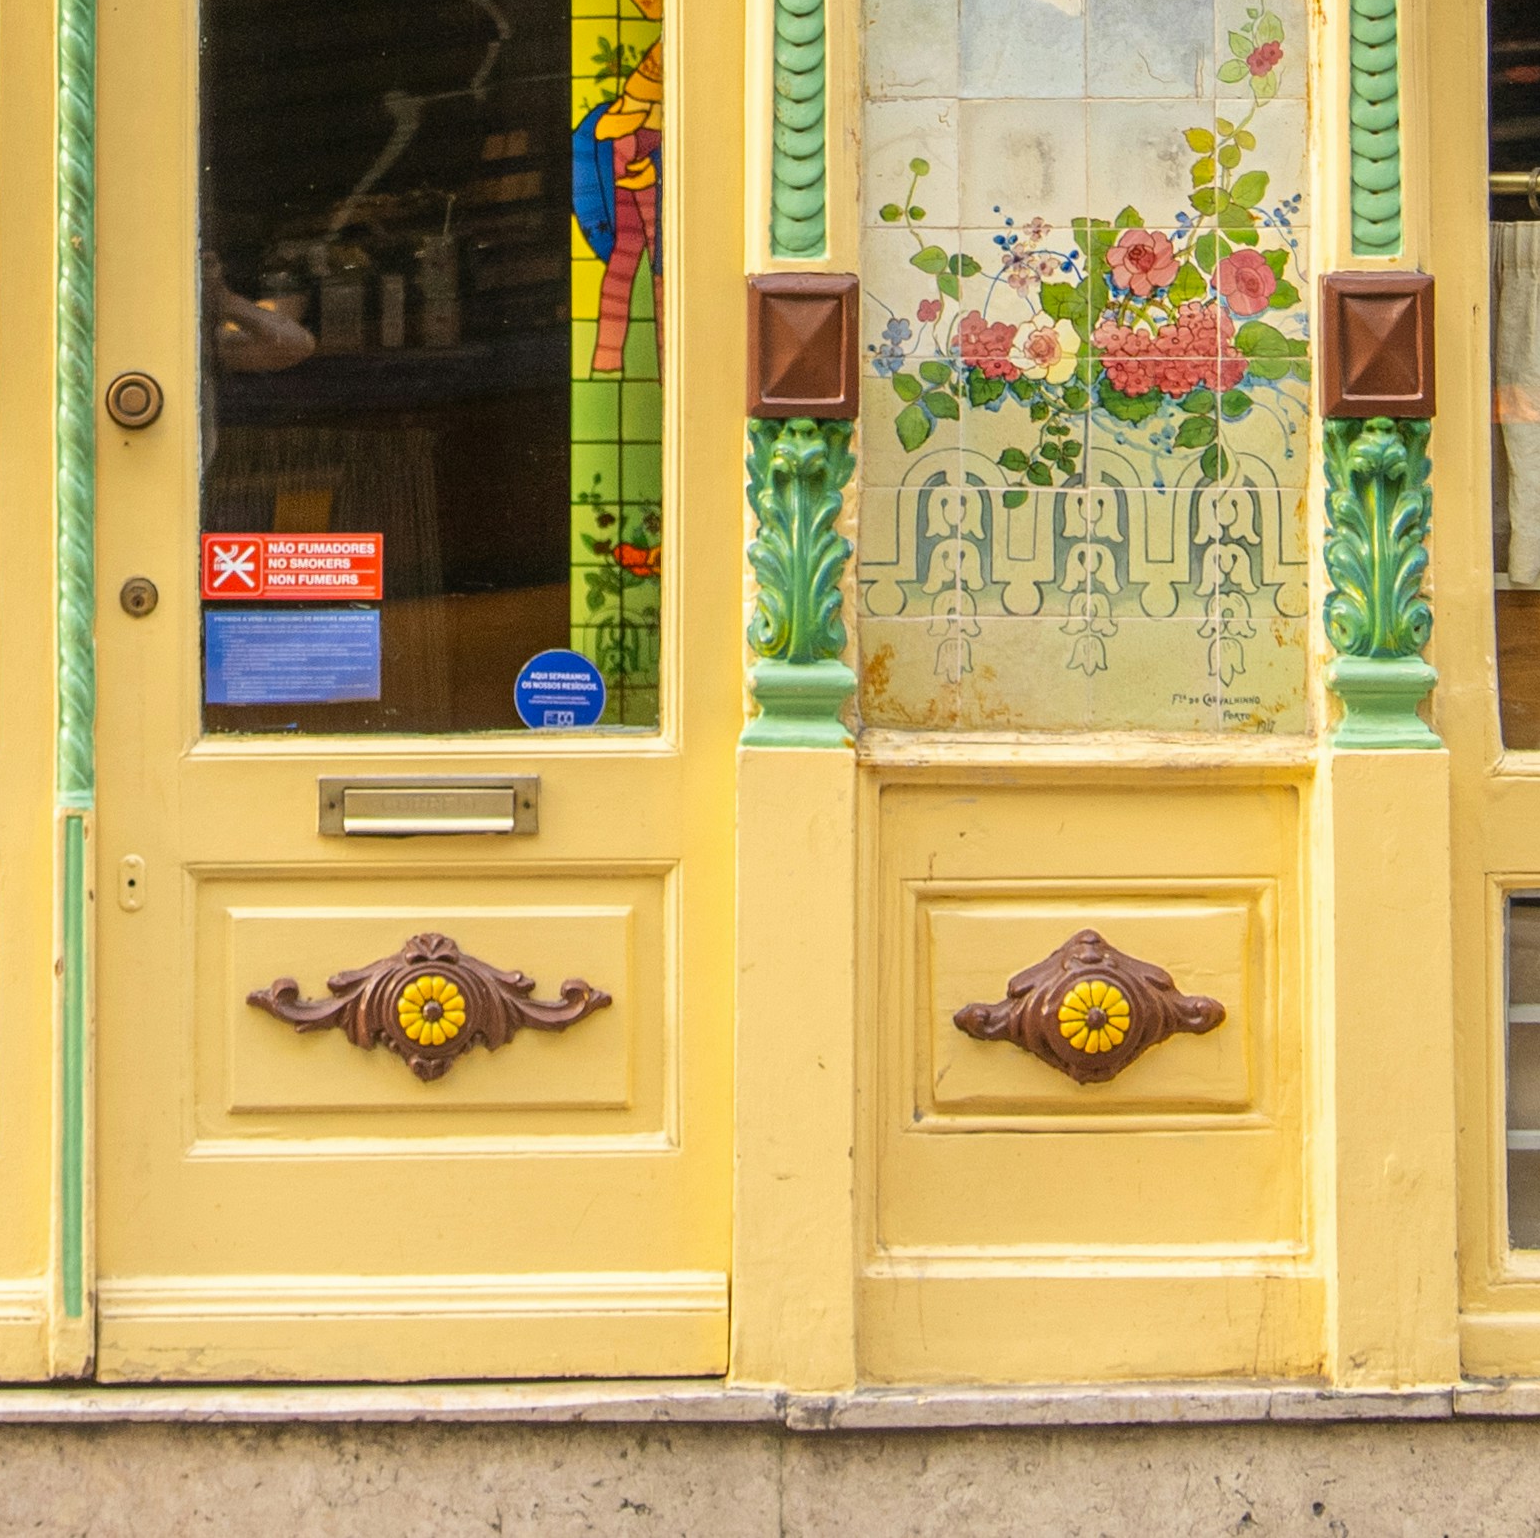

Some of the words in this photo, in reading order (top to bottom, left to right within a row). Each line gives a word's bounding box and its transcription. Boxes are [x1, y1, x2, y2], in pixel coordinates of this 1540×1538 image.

[268, 541, 296, 554] NÃO
[297, 542, 375, 555] FUMADORES
[268, 558, 288, 569] NO
[289, 558, 351, 570] SMOKERS
[268, 574, 296, 585] NON
[298, 574, 359, 585] FUMEURS
[530, 672, 548, 680] AQUI
[521, 681, 532, 690] OS
[532, 681, 561, 690] NOSSOS
